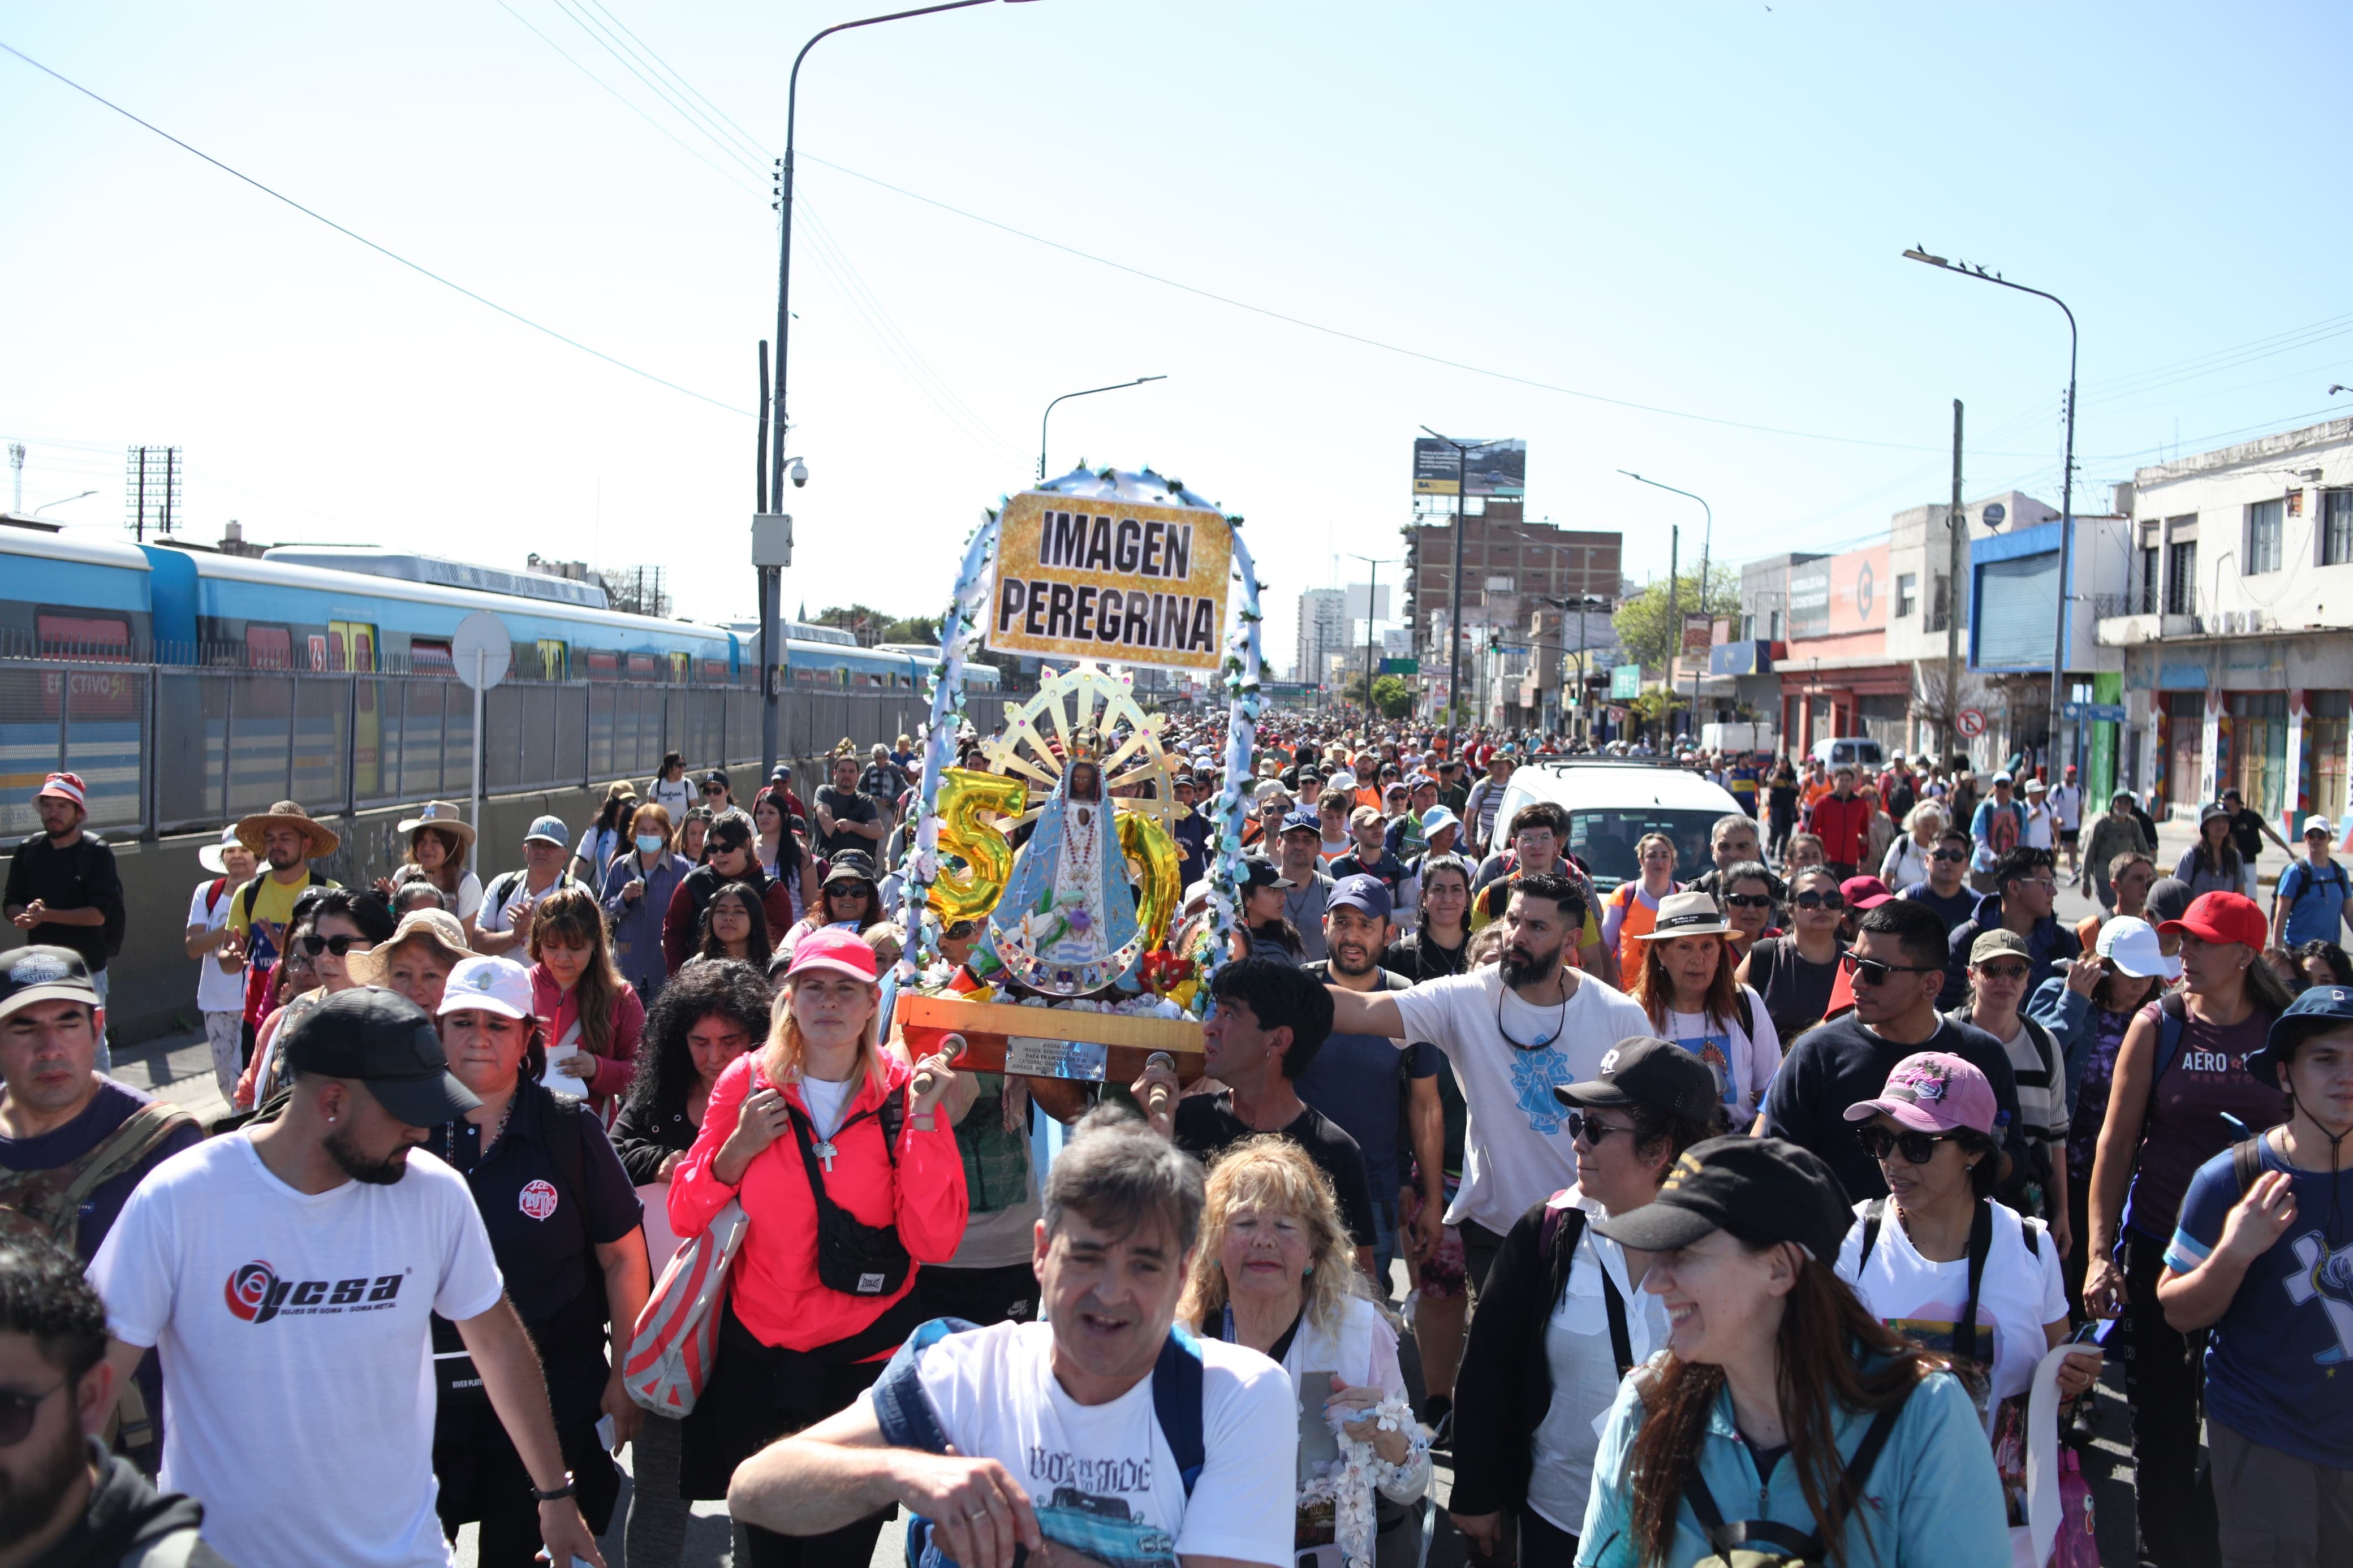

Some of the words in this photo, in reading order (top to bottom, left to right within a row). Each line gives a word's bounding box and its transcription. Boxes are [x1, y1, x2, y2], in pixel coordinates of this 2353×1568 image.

[1038, 511, 1193, 581] IMAGEN
[998, 577, 1216, 655] PEREGRINA
[2182, 1052, 2227, 1072] AERO
[373, 1302, 397, 1311] METAL
[1096, 1457, 1152, 1493] RIDE
